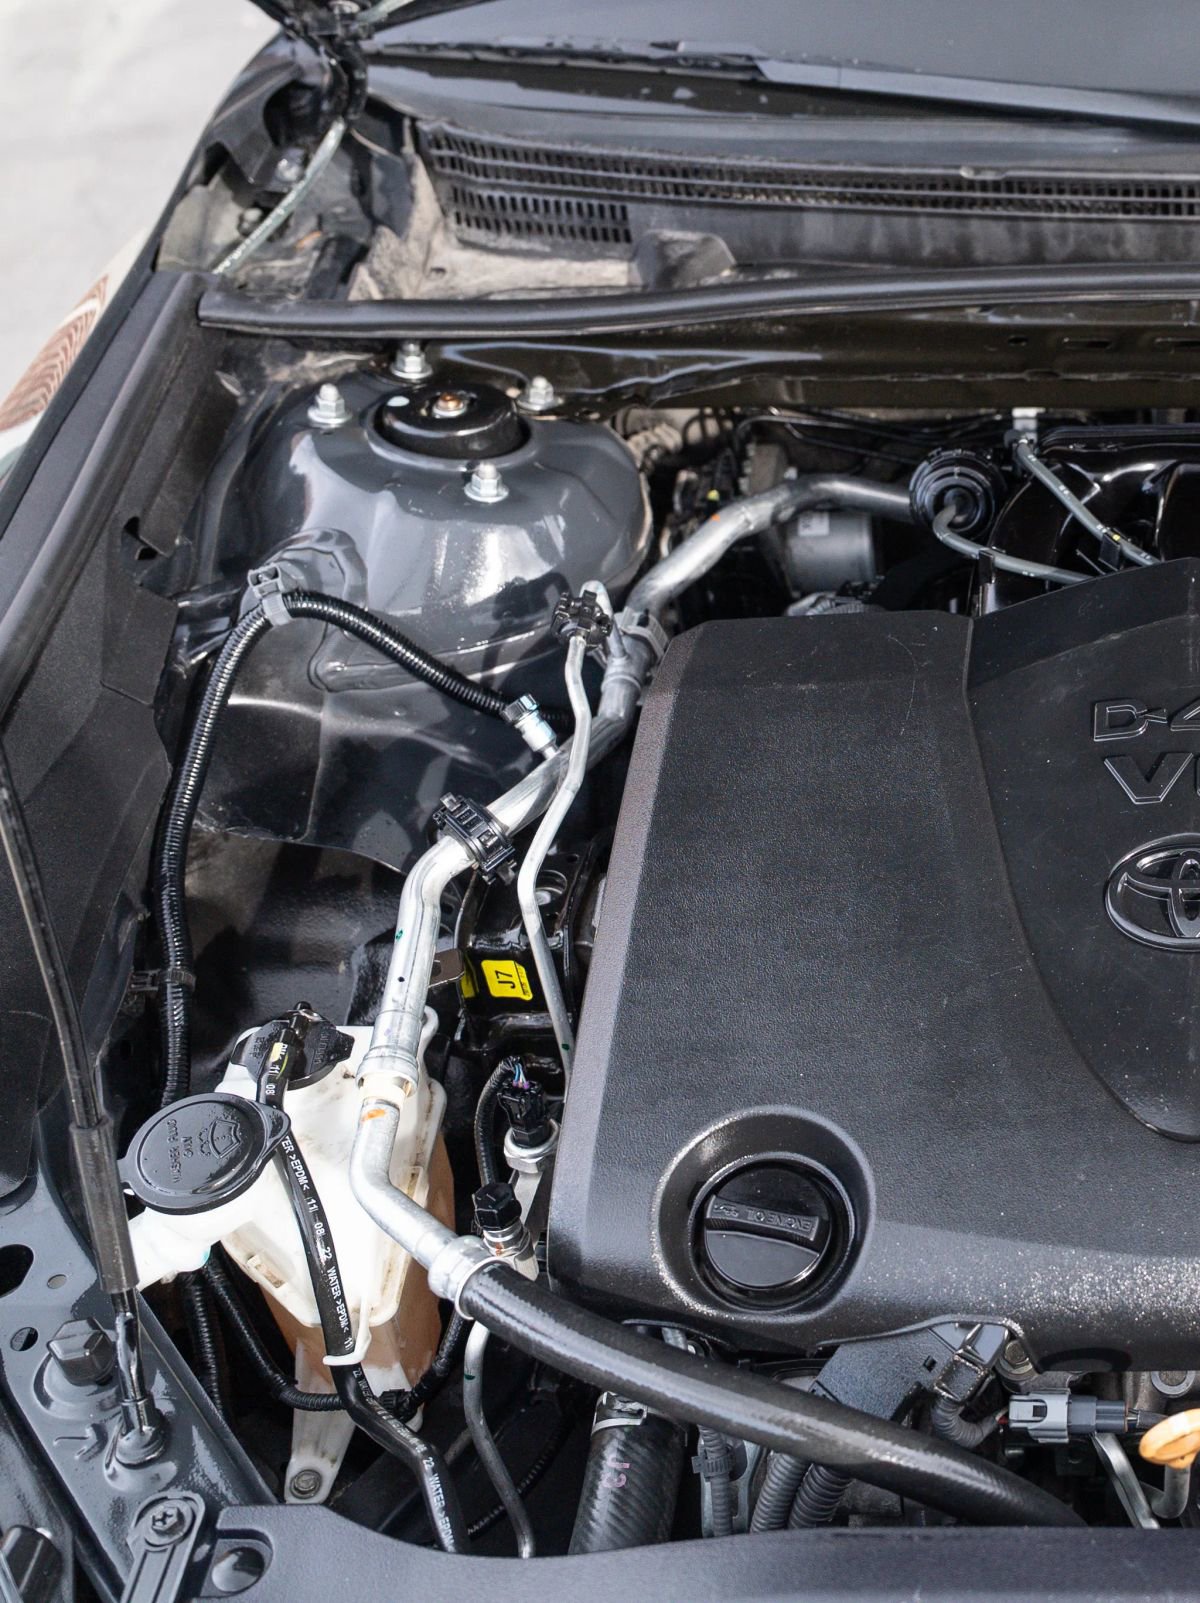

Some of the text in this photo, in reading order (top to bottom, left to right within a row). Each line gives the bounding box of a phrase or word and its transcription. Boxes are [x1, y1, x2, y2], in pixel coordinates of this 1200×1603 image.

[494, 970, 516, 989] J7
[326, 1265, 342, 1300] WATER
[422, 1456, 435, 1471] 22
[428, 1473, 446, 1508] WATER
